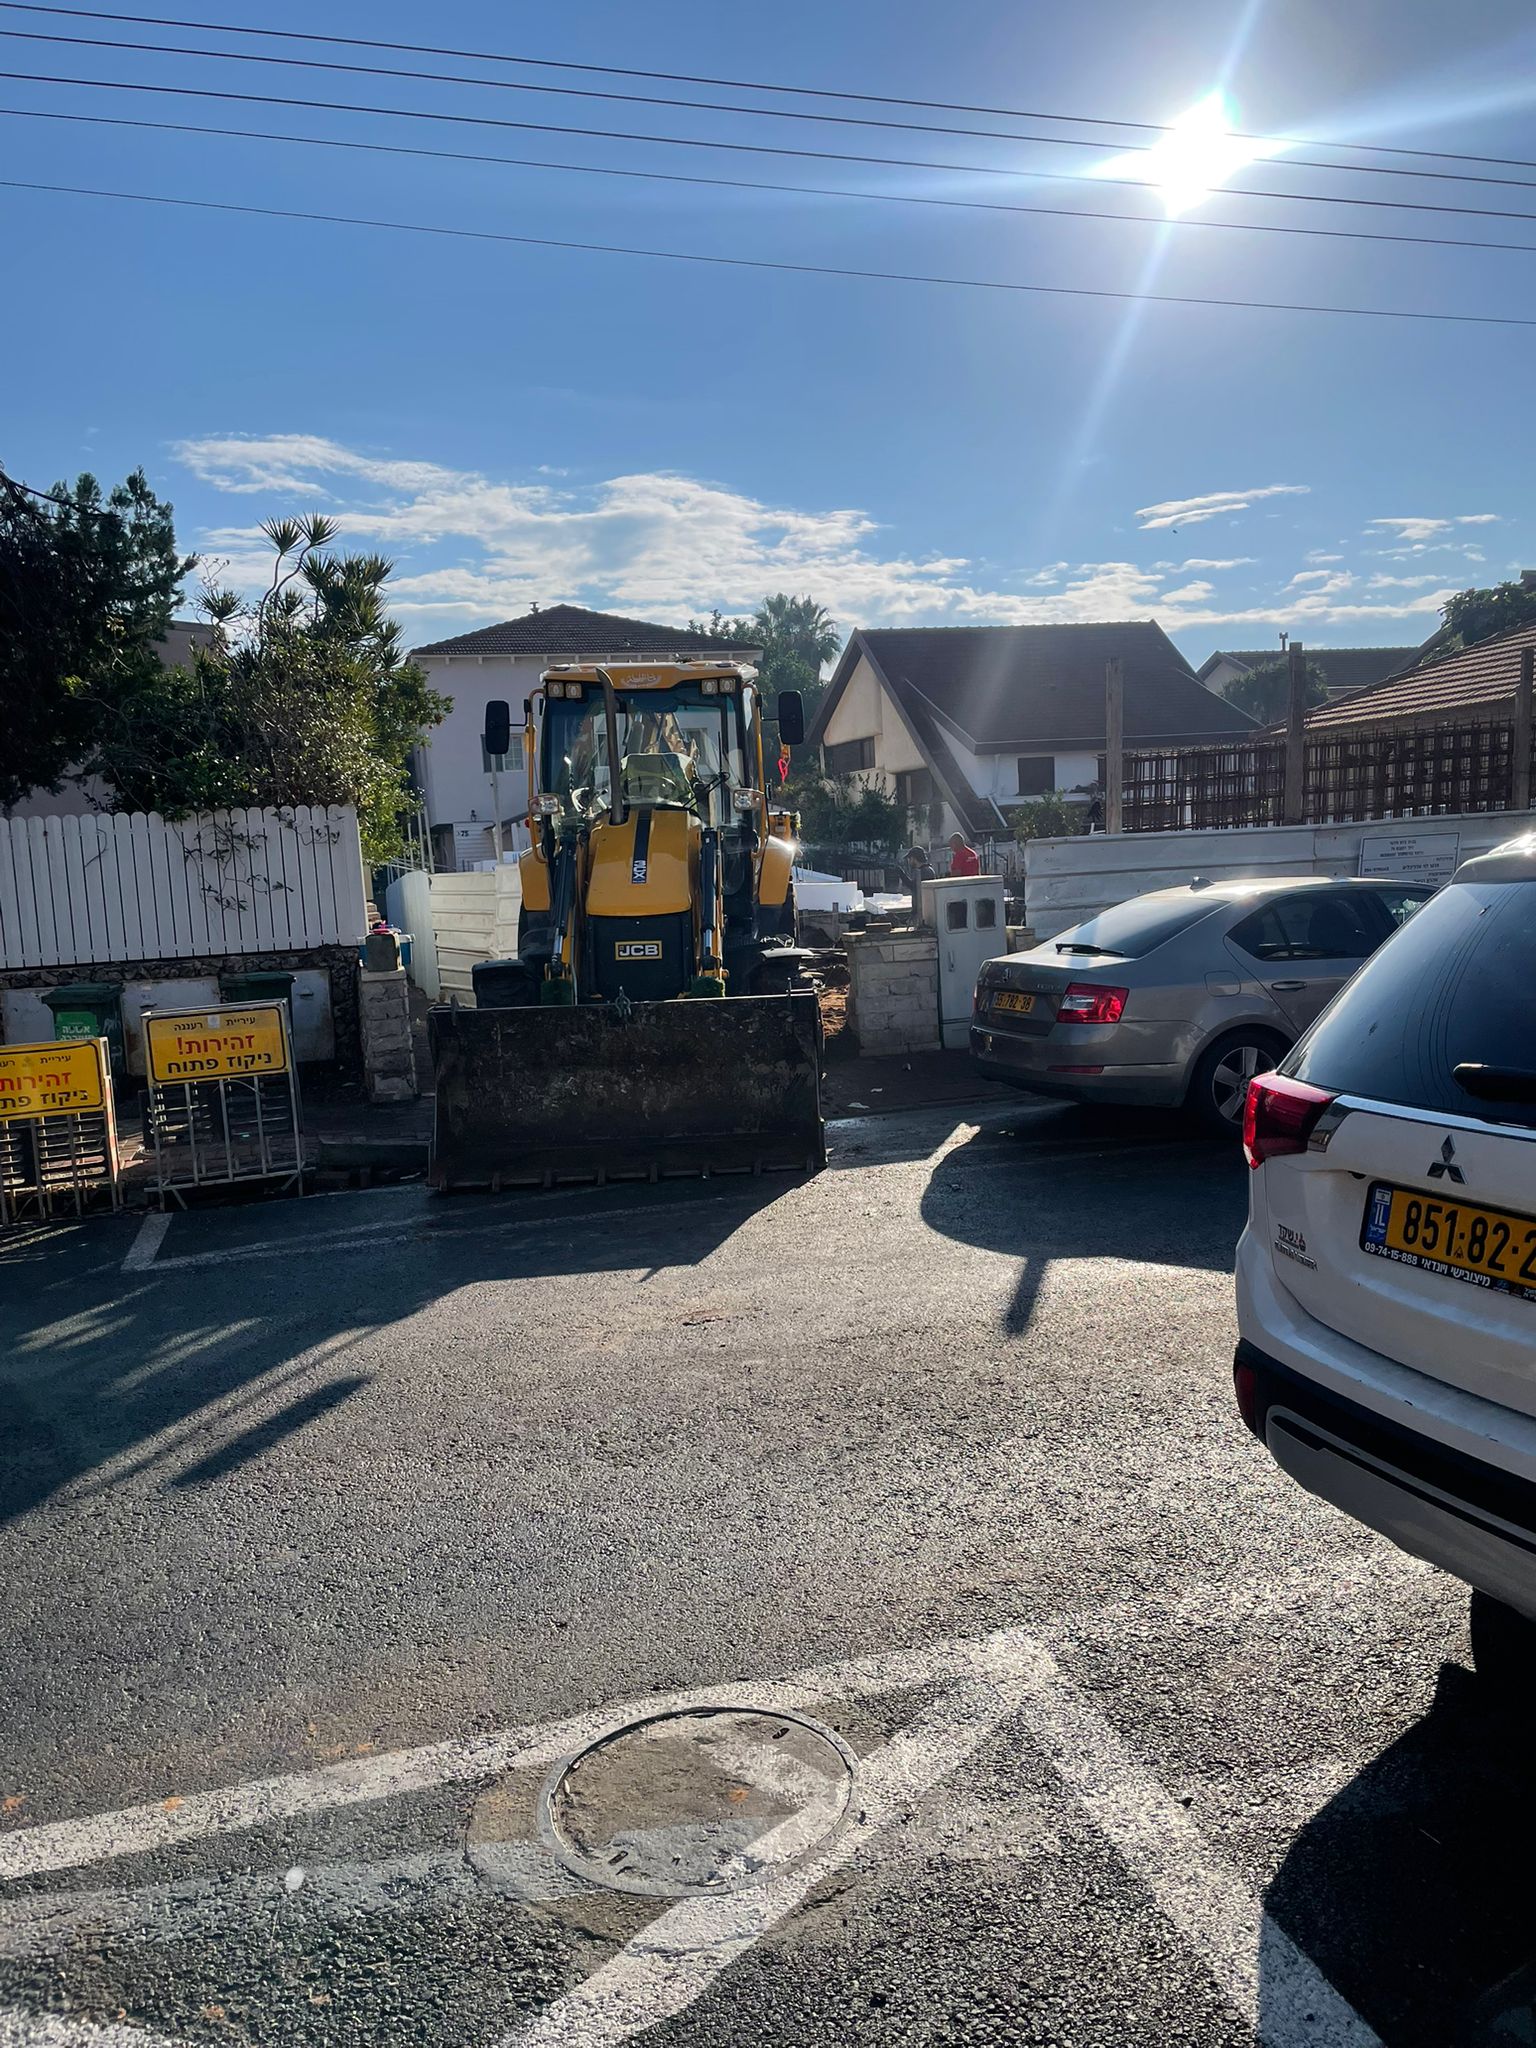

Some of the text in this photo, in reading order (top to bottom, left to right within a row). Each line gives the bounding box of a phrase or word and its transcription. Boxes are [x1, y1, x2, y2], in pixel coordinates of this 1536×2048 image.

[619, 944, 659, 956] JCB
[174, 1016, 256, 1031] עיריית רעננה
[177, 1035, 255, 1055] זהירות!
[40, 1055, 72, 1064] עיריית
[168, 1053, 272, 1073] ניקוז פתוח
[1374, 1204, 1386, 1226] IL
[1451, 1265, 1491, 1287] מיצובישי
